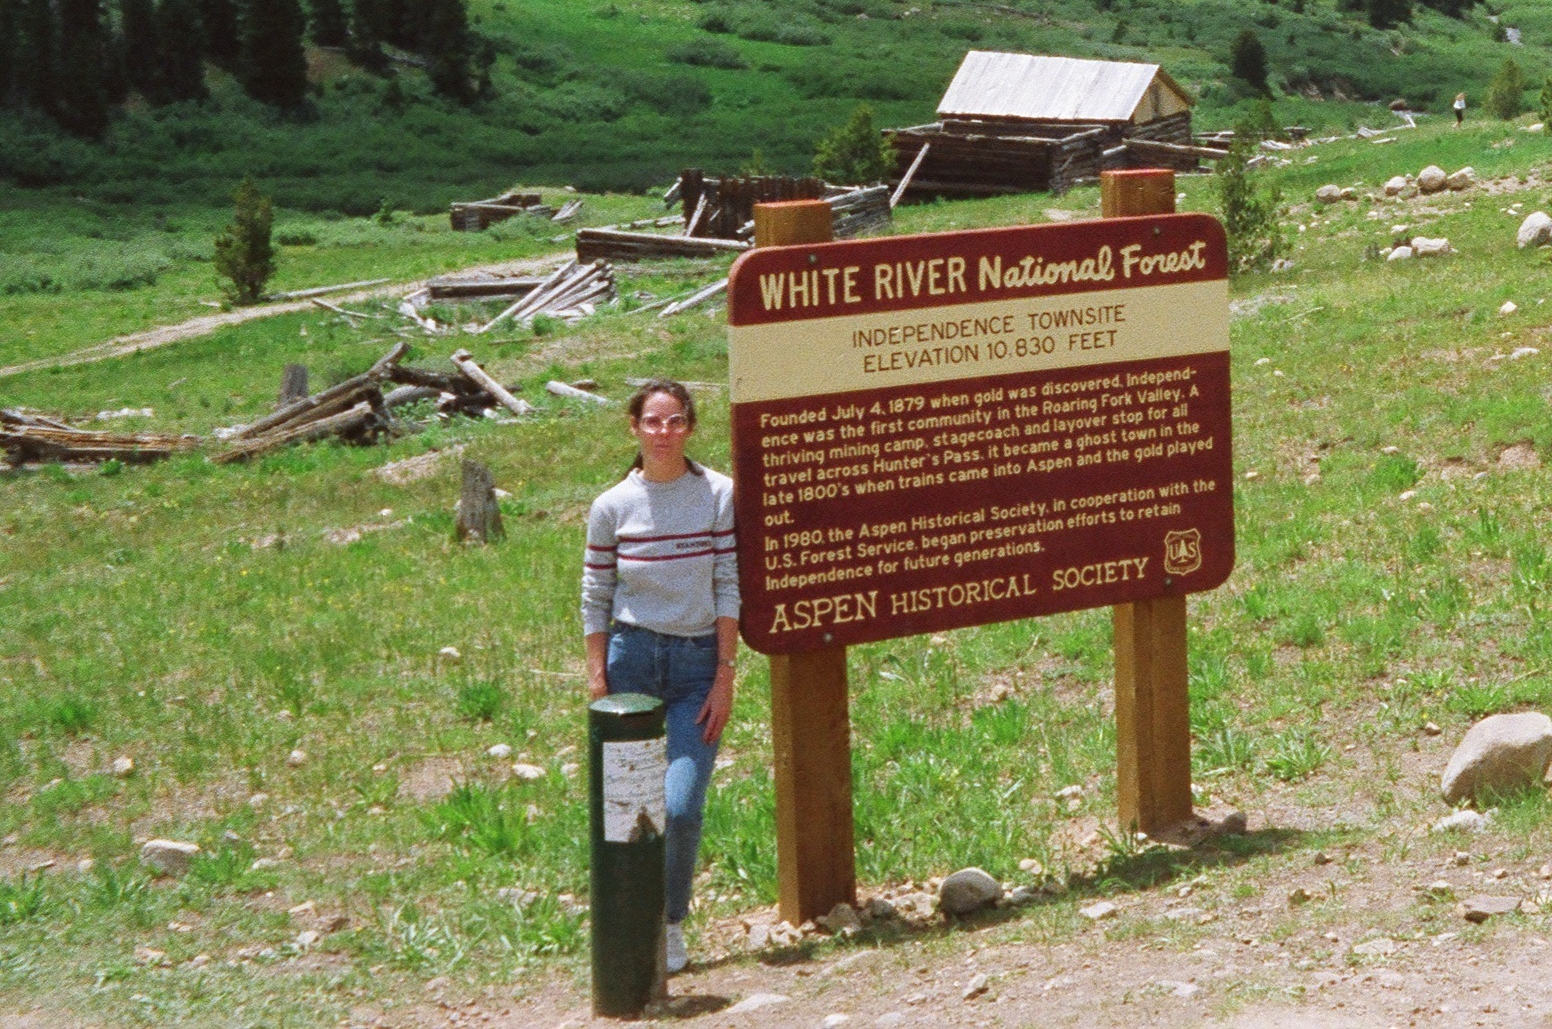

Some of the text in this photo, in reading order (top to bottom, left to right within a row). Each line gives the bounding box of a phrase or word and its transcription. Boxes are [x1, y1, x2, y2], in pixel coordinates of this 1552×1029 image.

[759, 240, 1206, 311] WHITE RIVER National Forest
[852, 304, 1126, 348] INDEPENDENCE TOWNSITE
[864, 344, 978, 373] ELEVATION
[1069, 330, 1117, 351] FEET
[760, 407, 827, 428] Founded
[831, 404, 865, 420] July
[888, 395, 925, 413] 1879
[930, 393, 969, 409] when
[974, 387, 1003, 407] gold
[1008, 386, 1036, 400] was
[1126, 367, 1197, 387] Independ-
[761, 384, 1199, 448] ence was the first community in the Roaring Fork Valley. A
[763, 449, 824, 468] thriving
[829, 442, 879, 459] mining
[933, 424, 1020, 447] stagecoach
[1024, 420, 1050, 435] and
[1053, 414, 1107, 433] layover
[1112, 410, 1143, 425] stop
[1148, 406, 1167, 420] for
[1172, 402, 1188, 418] all
[763, 468, 812, 487] travel
[816, 463, 868, 480] across
[873, 453, 939, 473] Hunter's
[987, 445, 999, 458] it
[1003, 439, 1059, 458] became
[1064, 438, 1072, 449] a
[1076, 430, 1117, 451] ghost
[1121, 428, 1156, 442] town
[1160, 424, 1173, 437] in
[1176, 421, 1199, 436] the
[763, 436, 1213, 507] late 1800's when trains came into Aspen and the gold played
[764, 536, 779, 551] In
[828, 528, 853, 543] the
[859, 521, 907, 539] Aspen
[911, 508, 985, 531] Historical
[1053, 498, 1066, 512] in
[1070, 488, 1155, 509] cooperation
[1159, 481, 1189, 498] with
[1193, 479, 1215, 493] the
[764, 510, 794, 526] out.
[765, 553, 798, 570] U.S.
[801, 545, 852, 565] Forest
[921, 532, 966, 550] began
[970, 519, 1063, 544] preservation
[1067, 511, 1116, 529] efforts
[1120, 507, 1134, 521] to
[1138, 502, 1181, 519] retain
[765, 540, 1045, 591] Independence for future generations.
[768, 556, 1149, 633] ASPEN HISTORICAL SOCIETY
